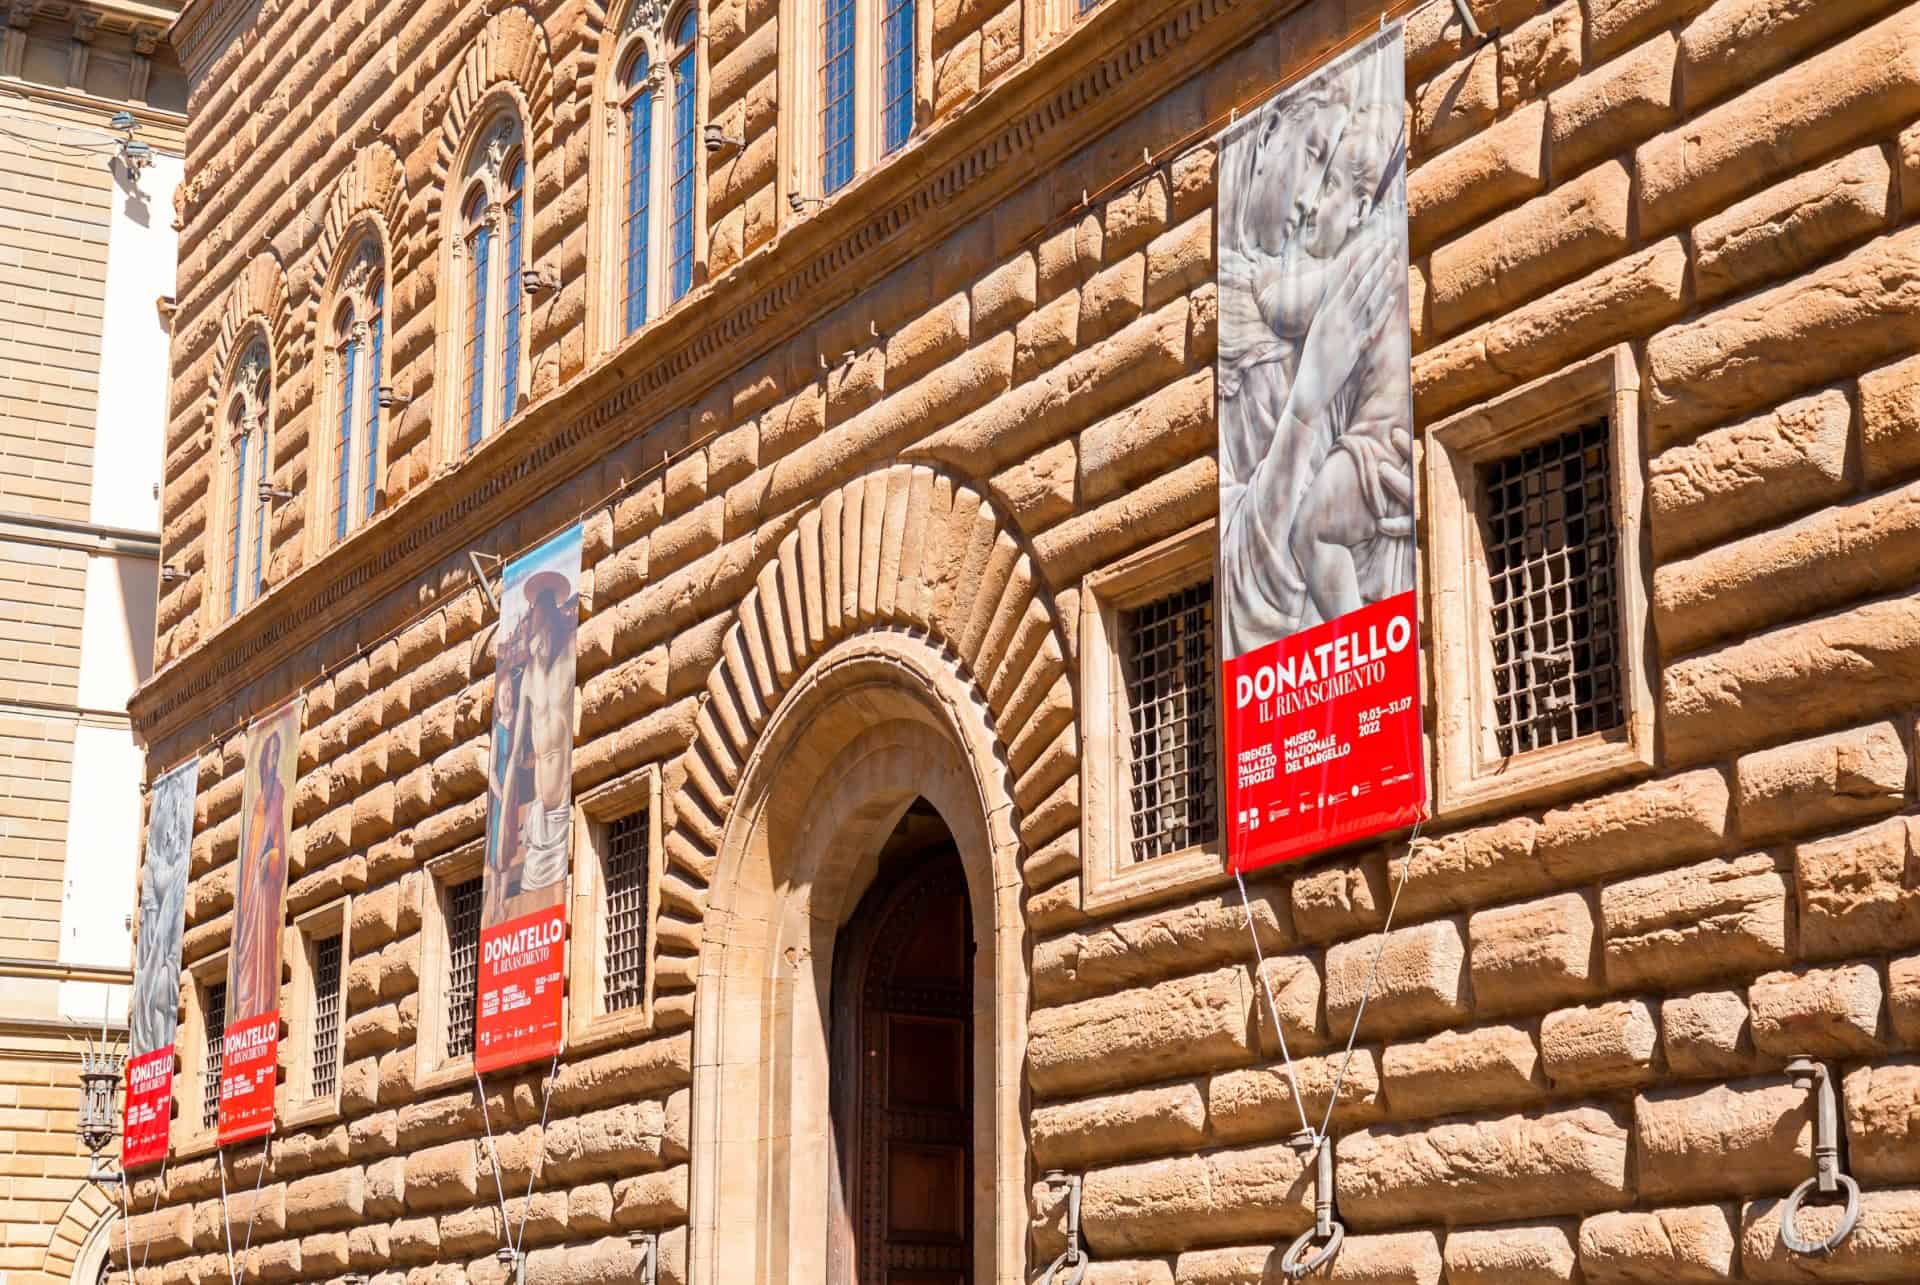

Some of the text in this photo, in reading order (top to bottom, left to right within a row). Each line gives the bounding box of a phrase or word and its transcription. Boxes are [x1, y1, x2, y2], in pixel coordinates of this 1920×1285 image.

[1236, 616, 1411, 709] DONATELLO
[1259, 660, 1386, 723] IL RINASCIMENTO
[1284, 729, 1317, 748] MUSEO
[1359, 720, 1381, 737] 2022
[1238, 743, 1272, 763] FIRENZE
[1285, 734, 1336, 760] NAZIONALE
[1285, 743, 1351, 774] DEL BARGELLO
[1238, 754, 1277, 777] PALAZZO
[1238, 767, 1275, 789] STROZZI
[484, 918, 562, 964] DONATELLO
